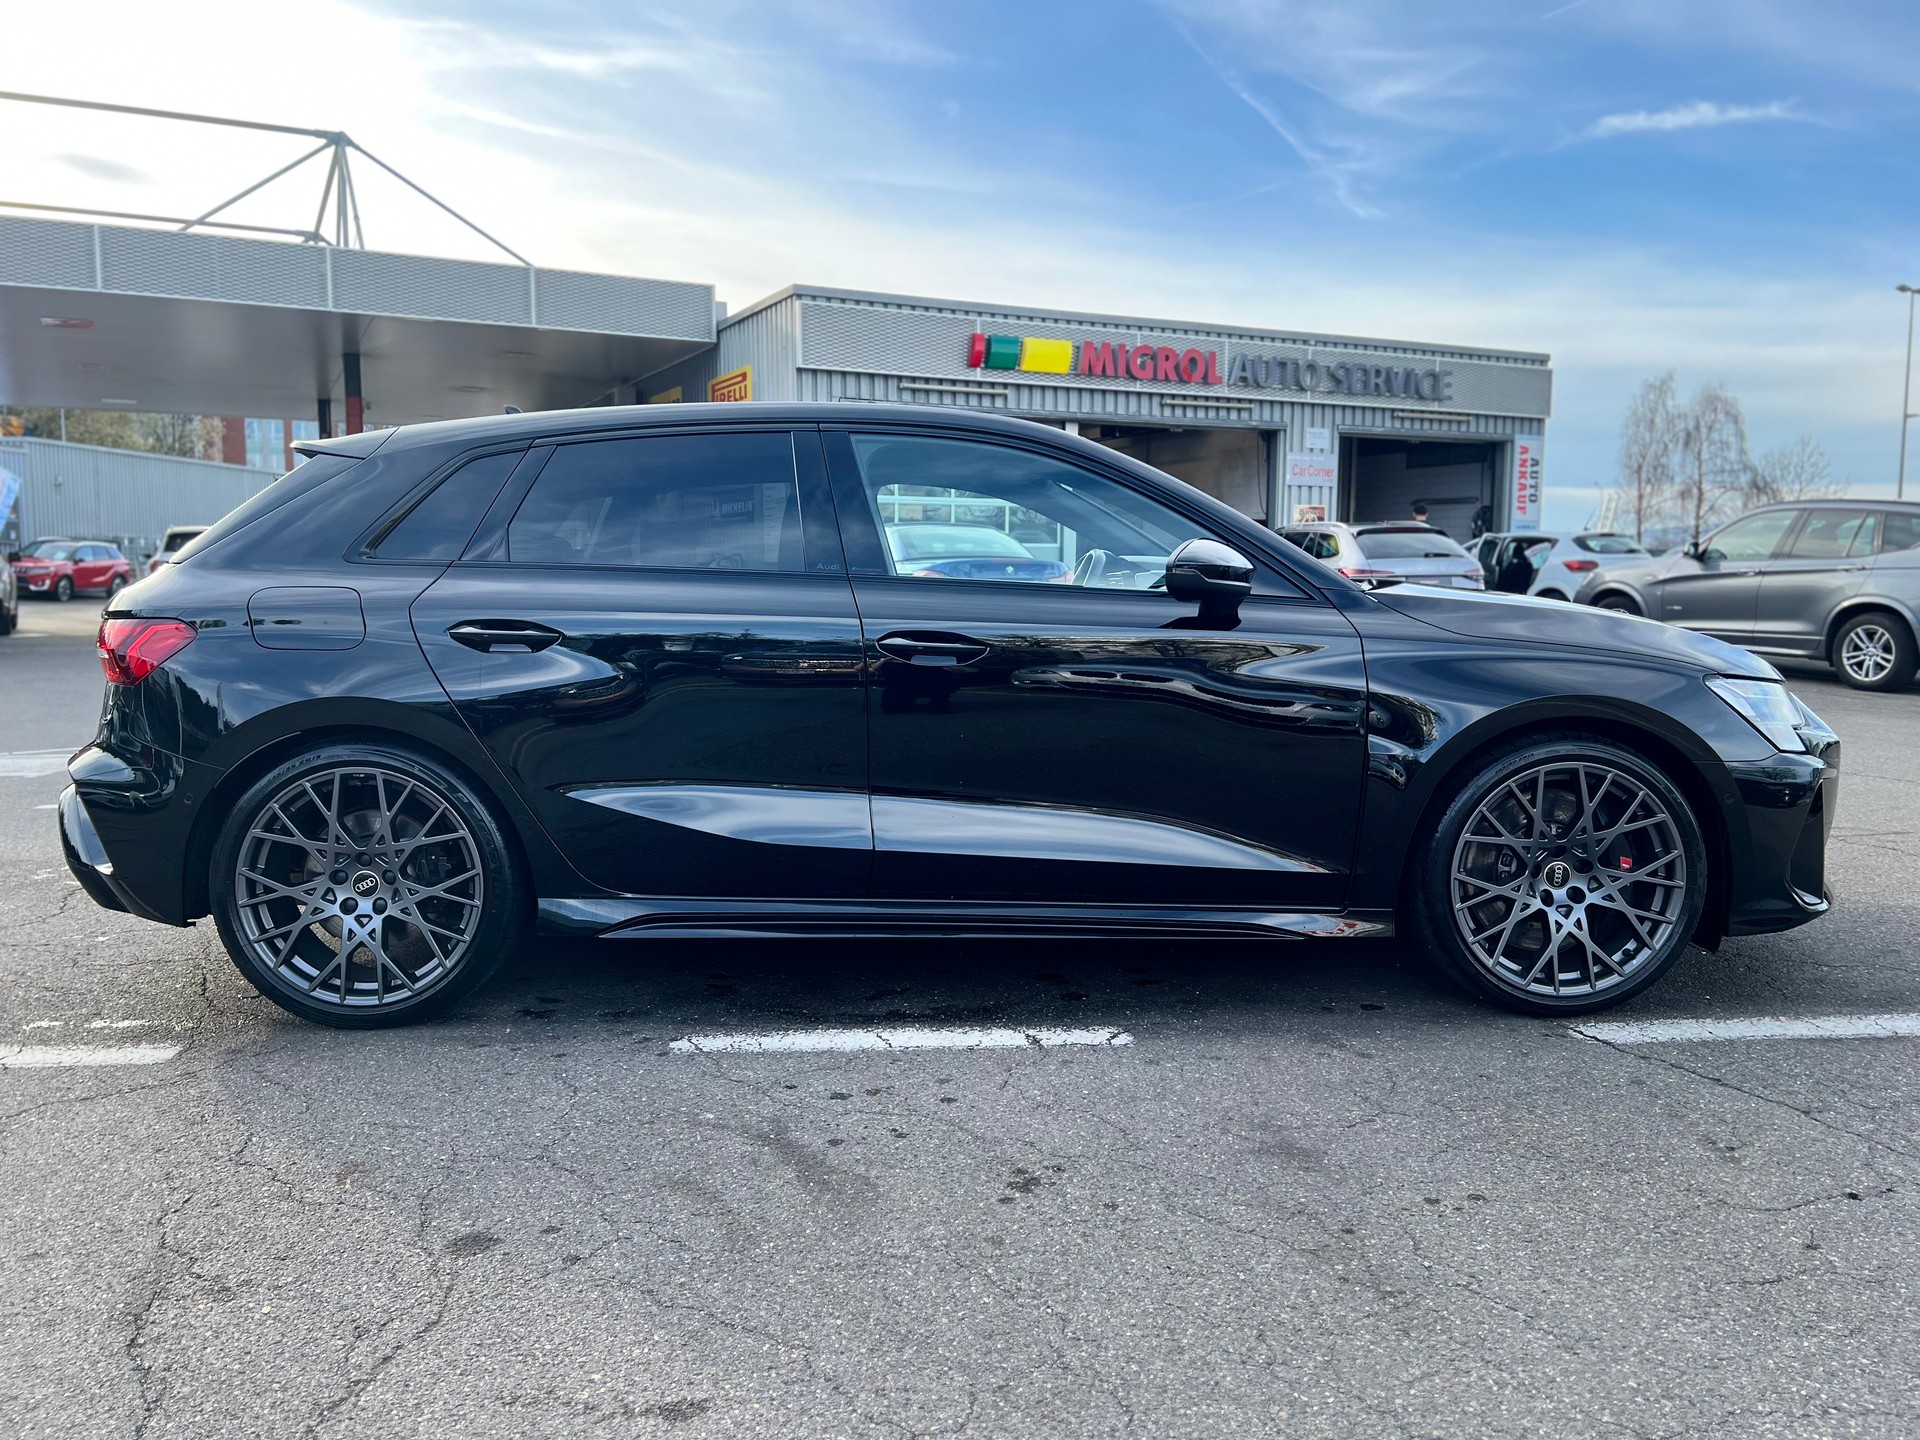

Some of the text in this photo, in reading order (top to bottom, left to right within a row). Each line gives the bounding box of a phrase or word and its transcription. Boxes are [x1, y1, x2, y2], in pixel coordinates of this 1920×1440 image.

[711, 371, 748, 403] PIRELLI
[1078, 339, 1453, 401] MIGROL AUTO SERVICE
[1517, 444, 1531, 515] ANKAUF
[1528, 457, 1540, 503] AUTO
[816, 562, 840, 571] Audi
